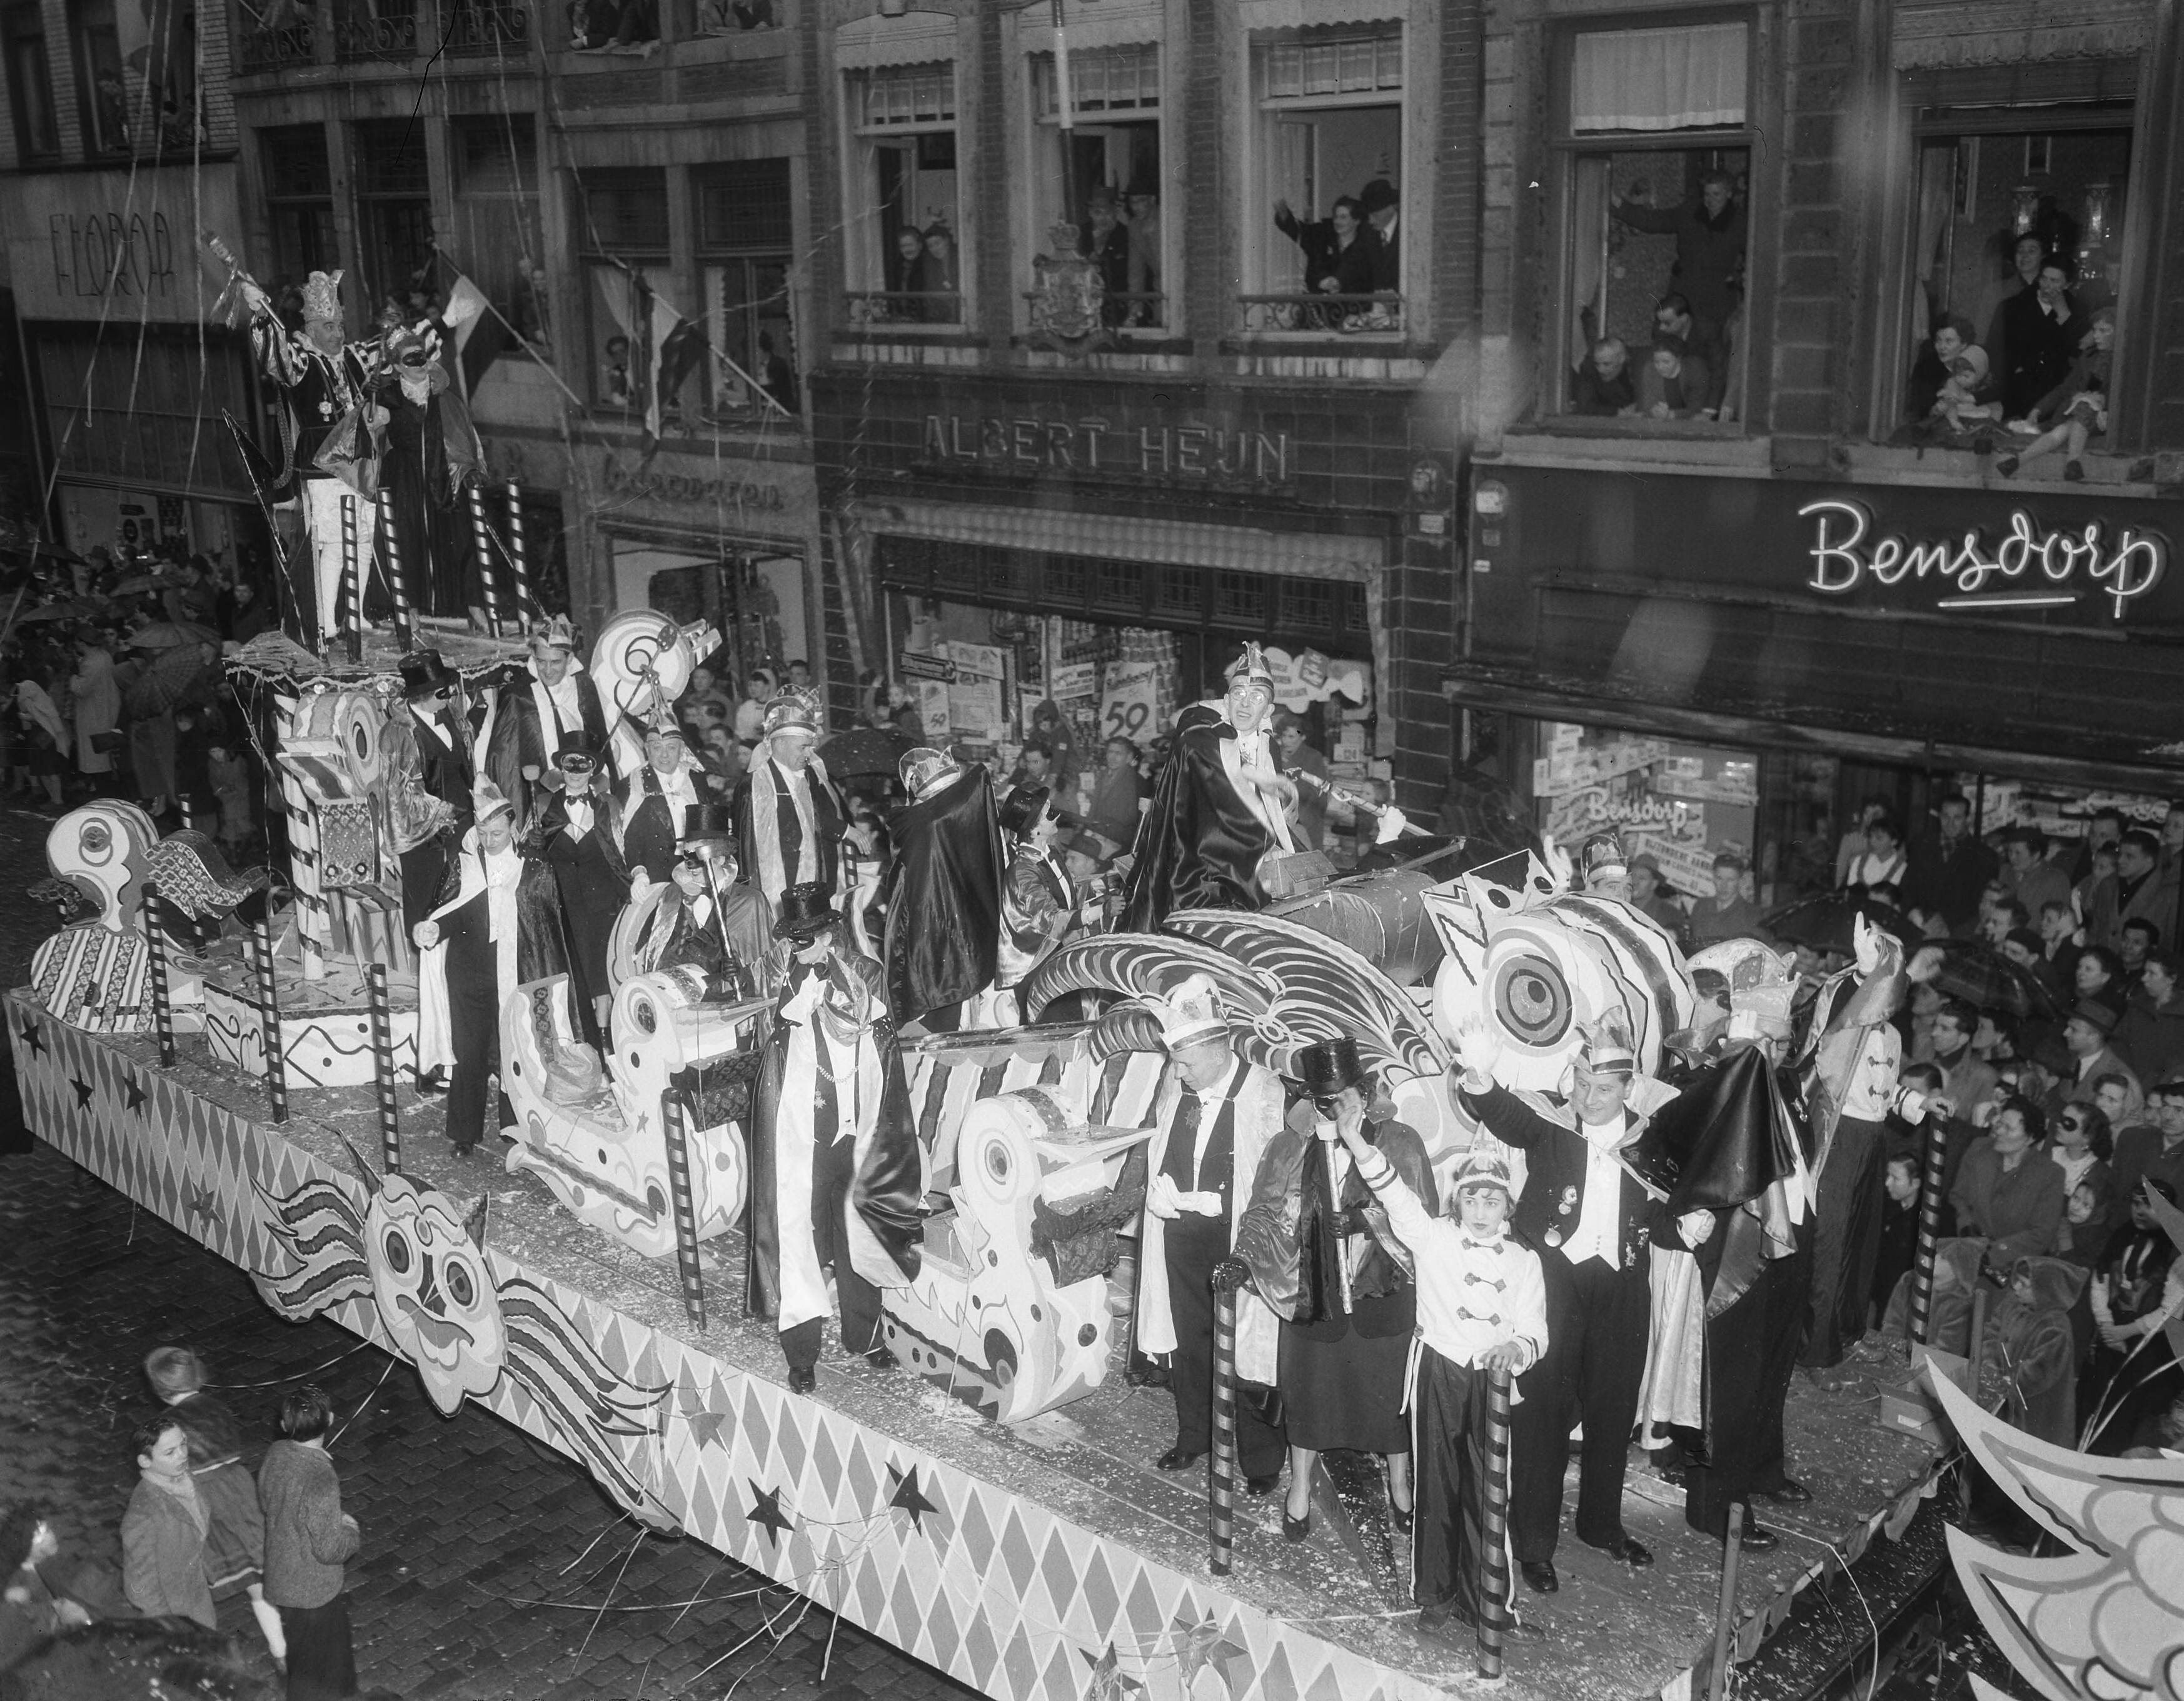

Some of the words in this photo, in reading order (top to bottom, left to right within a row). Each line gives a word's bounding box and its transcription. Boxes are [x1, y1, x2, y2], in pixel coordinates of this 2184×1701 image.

[924, 414, 1105, 467] ALBERT
[1797, 501, 2160, 618] Bensdorp
[1105, 701, 1149, 737] 59
[1574, 786, 1688, 837] Bensdorp
